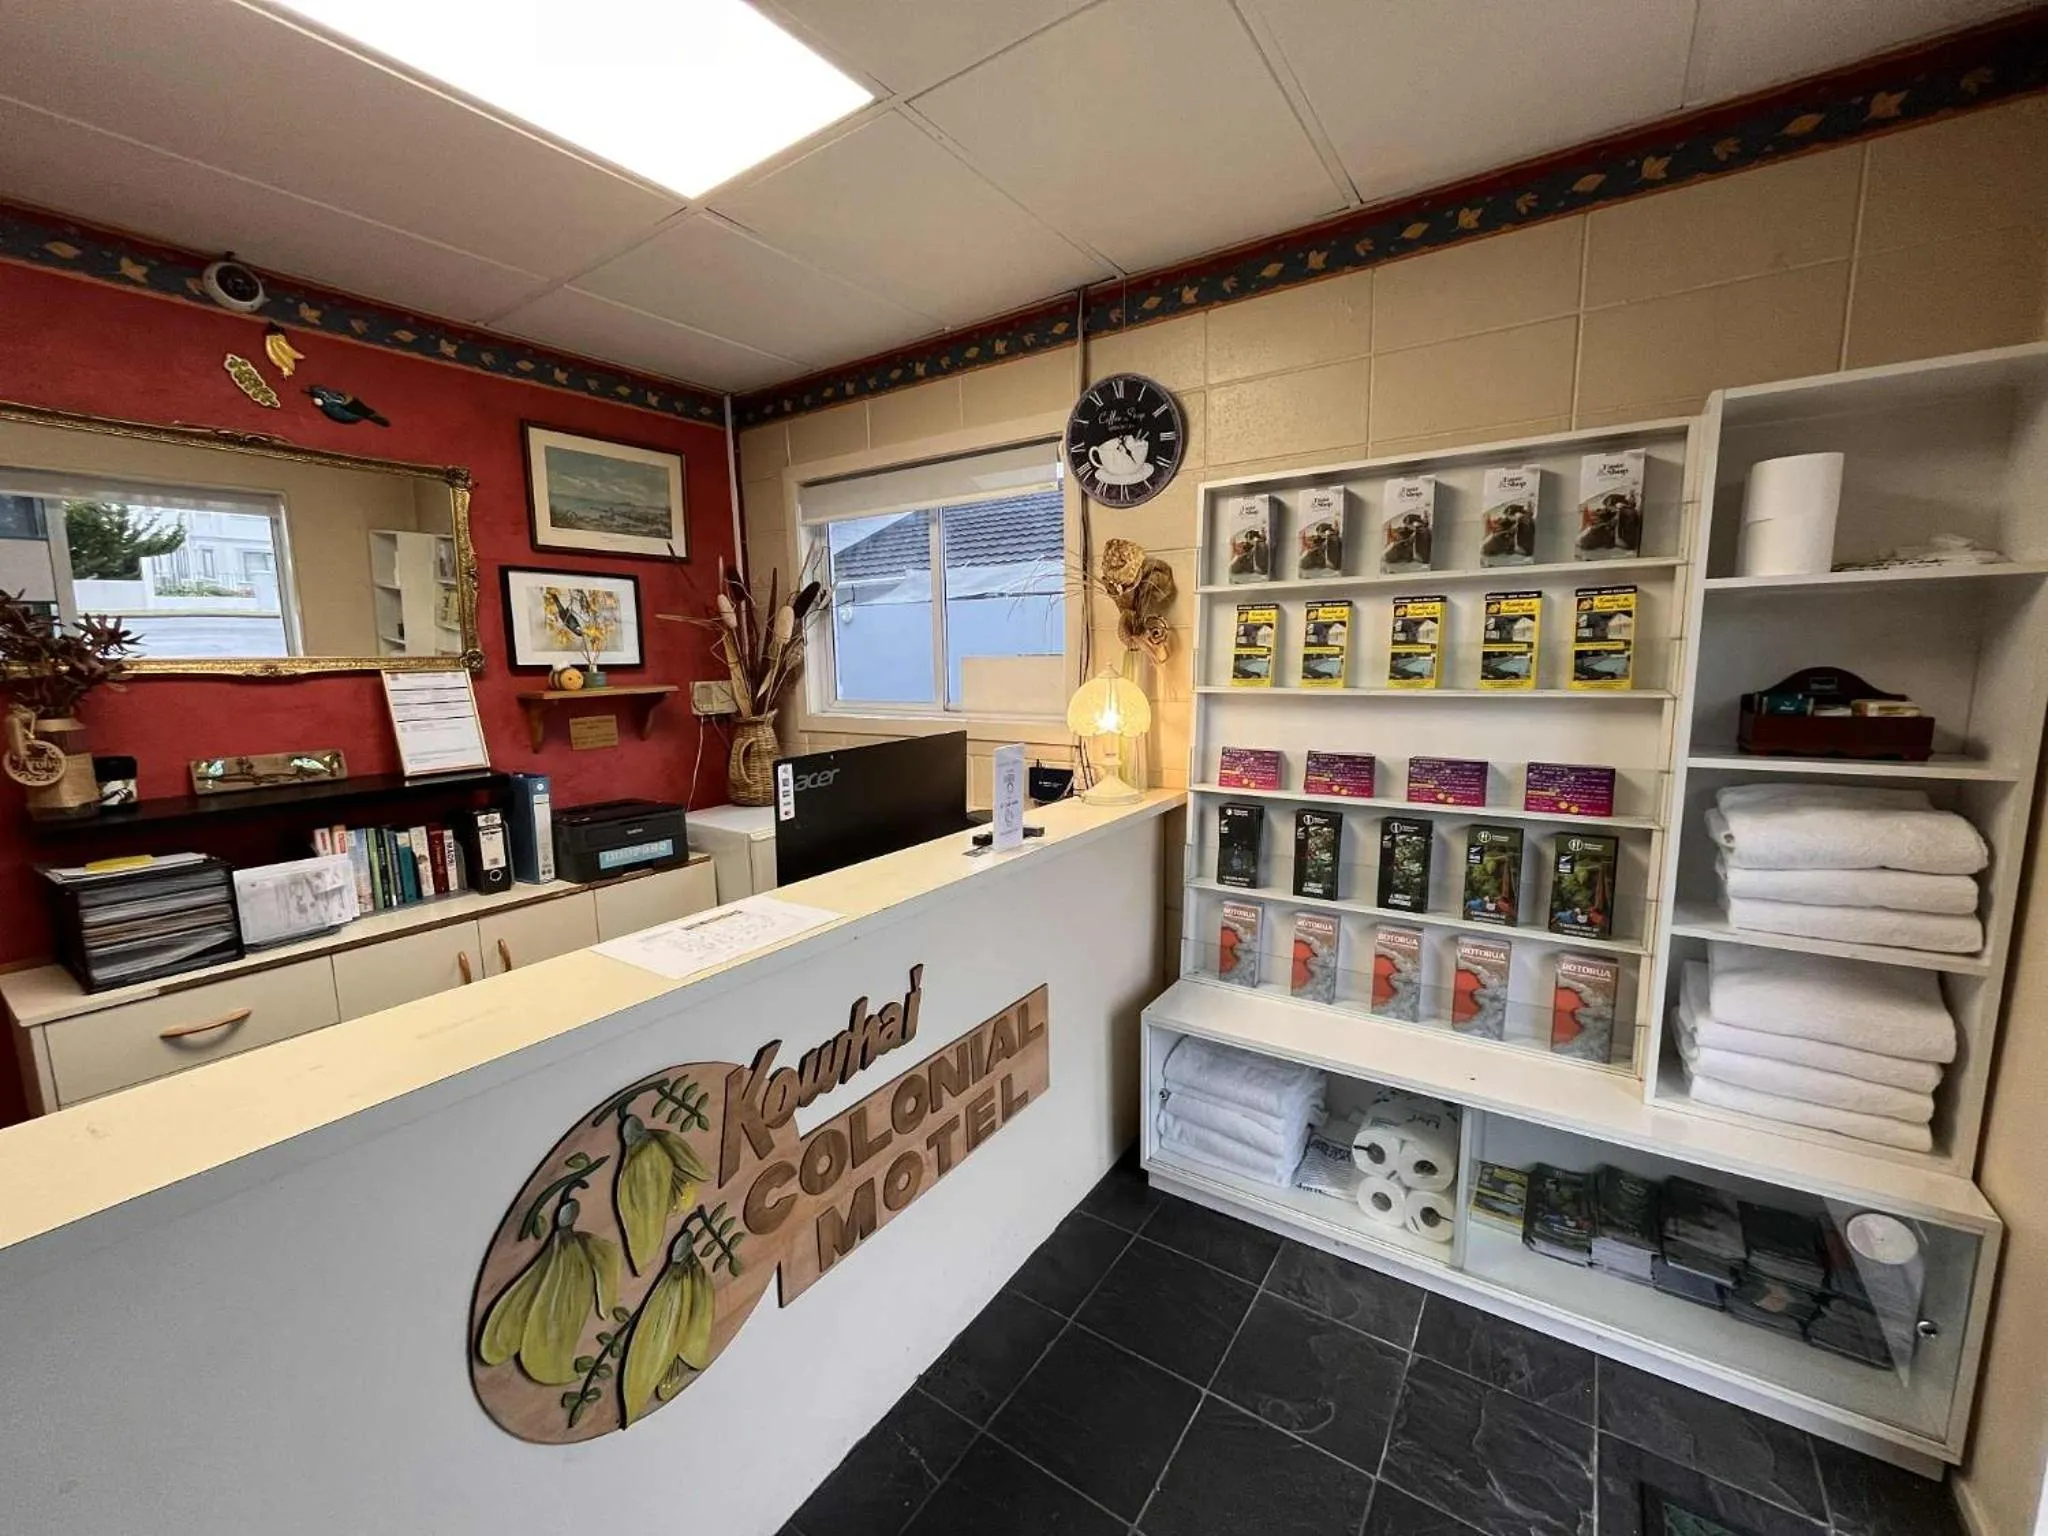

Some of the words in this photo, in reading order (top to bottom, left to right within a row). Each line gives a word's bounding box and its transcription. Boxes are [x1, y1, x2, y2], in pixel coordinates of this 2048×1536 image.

[794, 768, 840, 791] acer
[1378, 932, 1418, 947] ROTORUA
[1461, 947, 1506, 961] ROTORUA
[1561, 963, 1611, 979] ROTORUA
[718, 963, 924, 1189] Kowhai
[742, 1001, 1045, 1235] COLONIAL
[816, 1072, 1030, 1273] MOTEL
